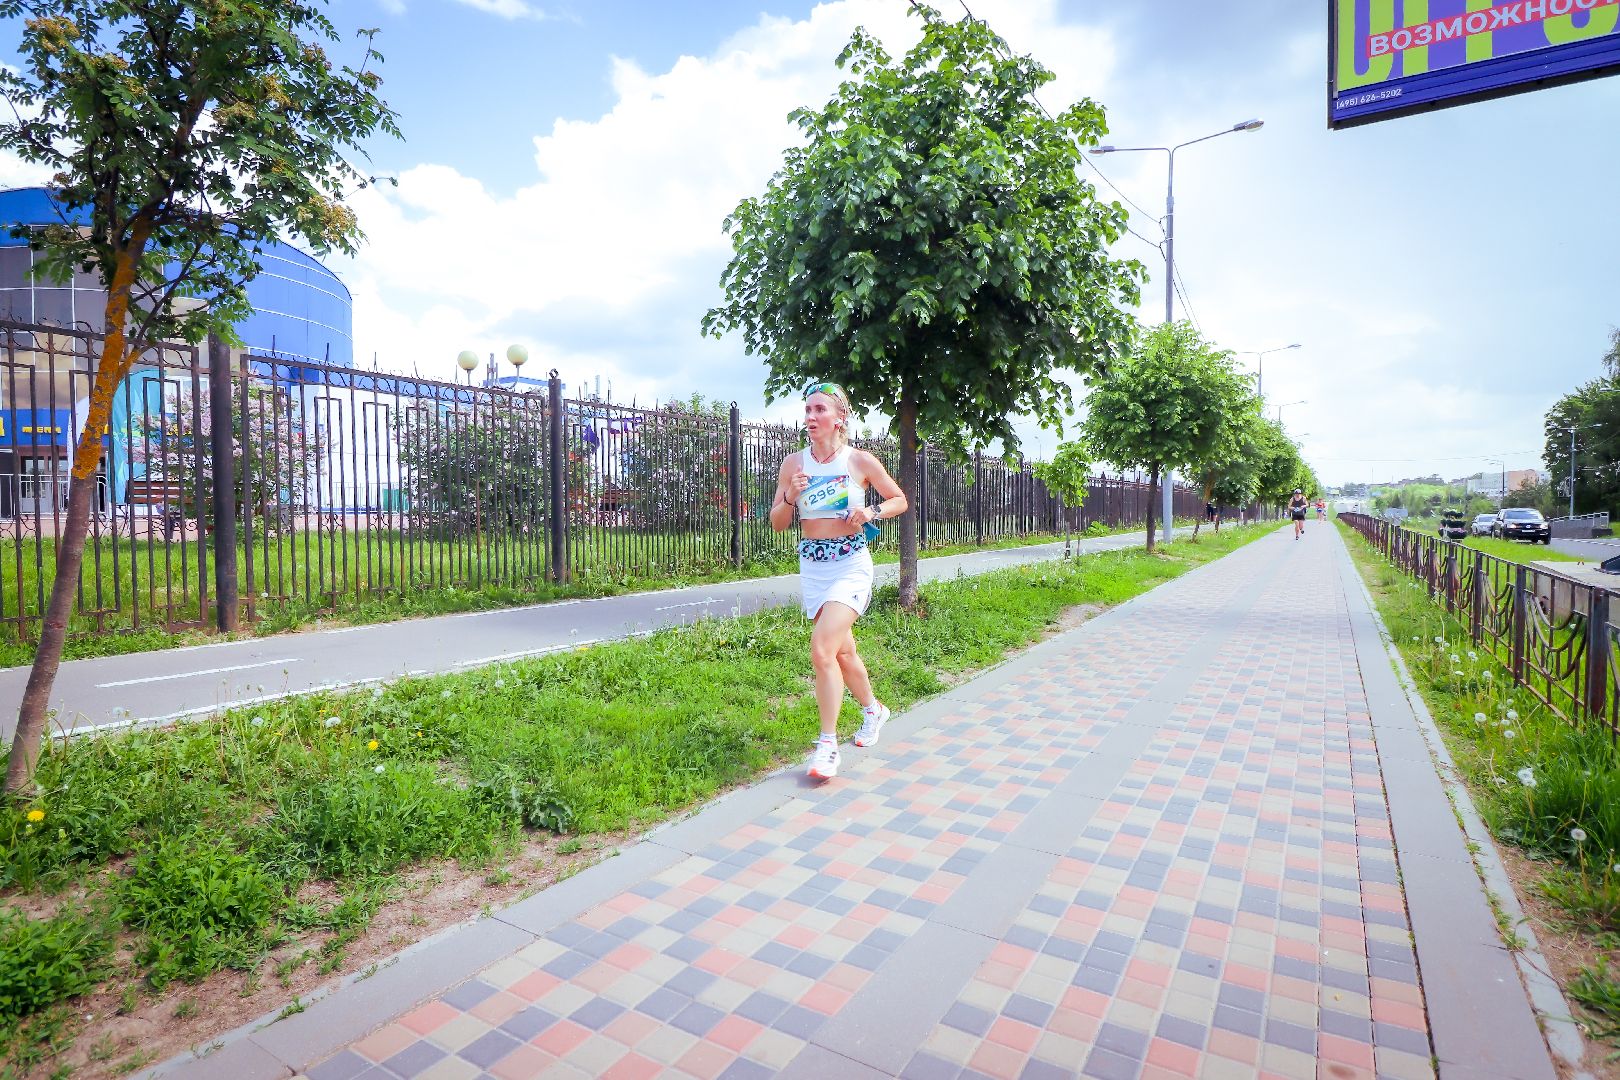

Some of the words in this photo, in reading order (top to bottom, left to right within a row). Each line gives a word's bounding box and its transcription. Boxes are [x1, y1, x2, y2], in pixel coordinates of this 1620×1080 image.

[1370, 0, 1615, 55] ВОЗМОЖНО
[1360, 88, 1402, 103] 626-5202
[808, 485, 836, 505] 296
